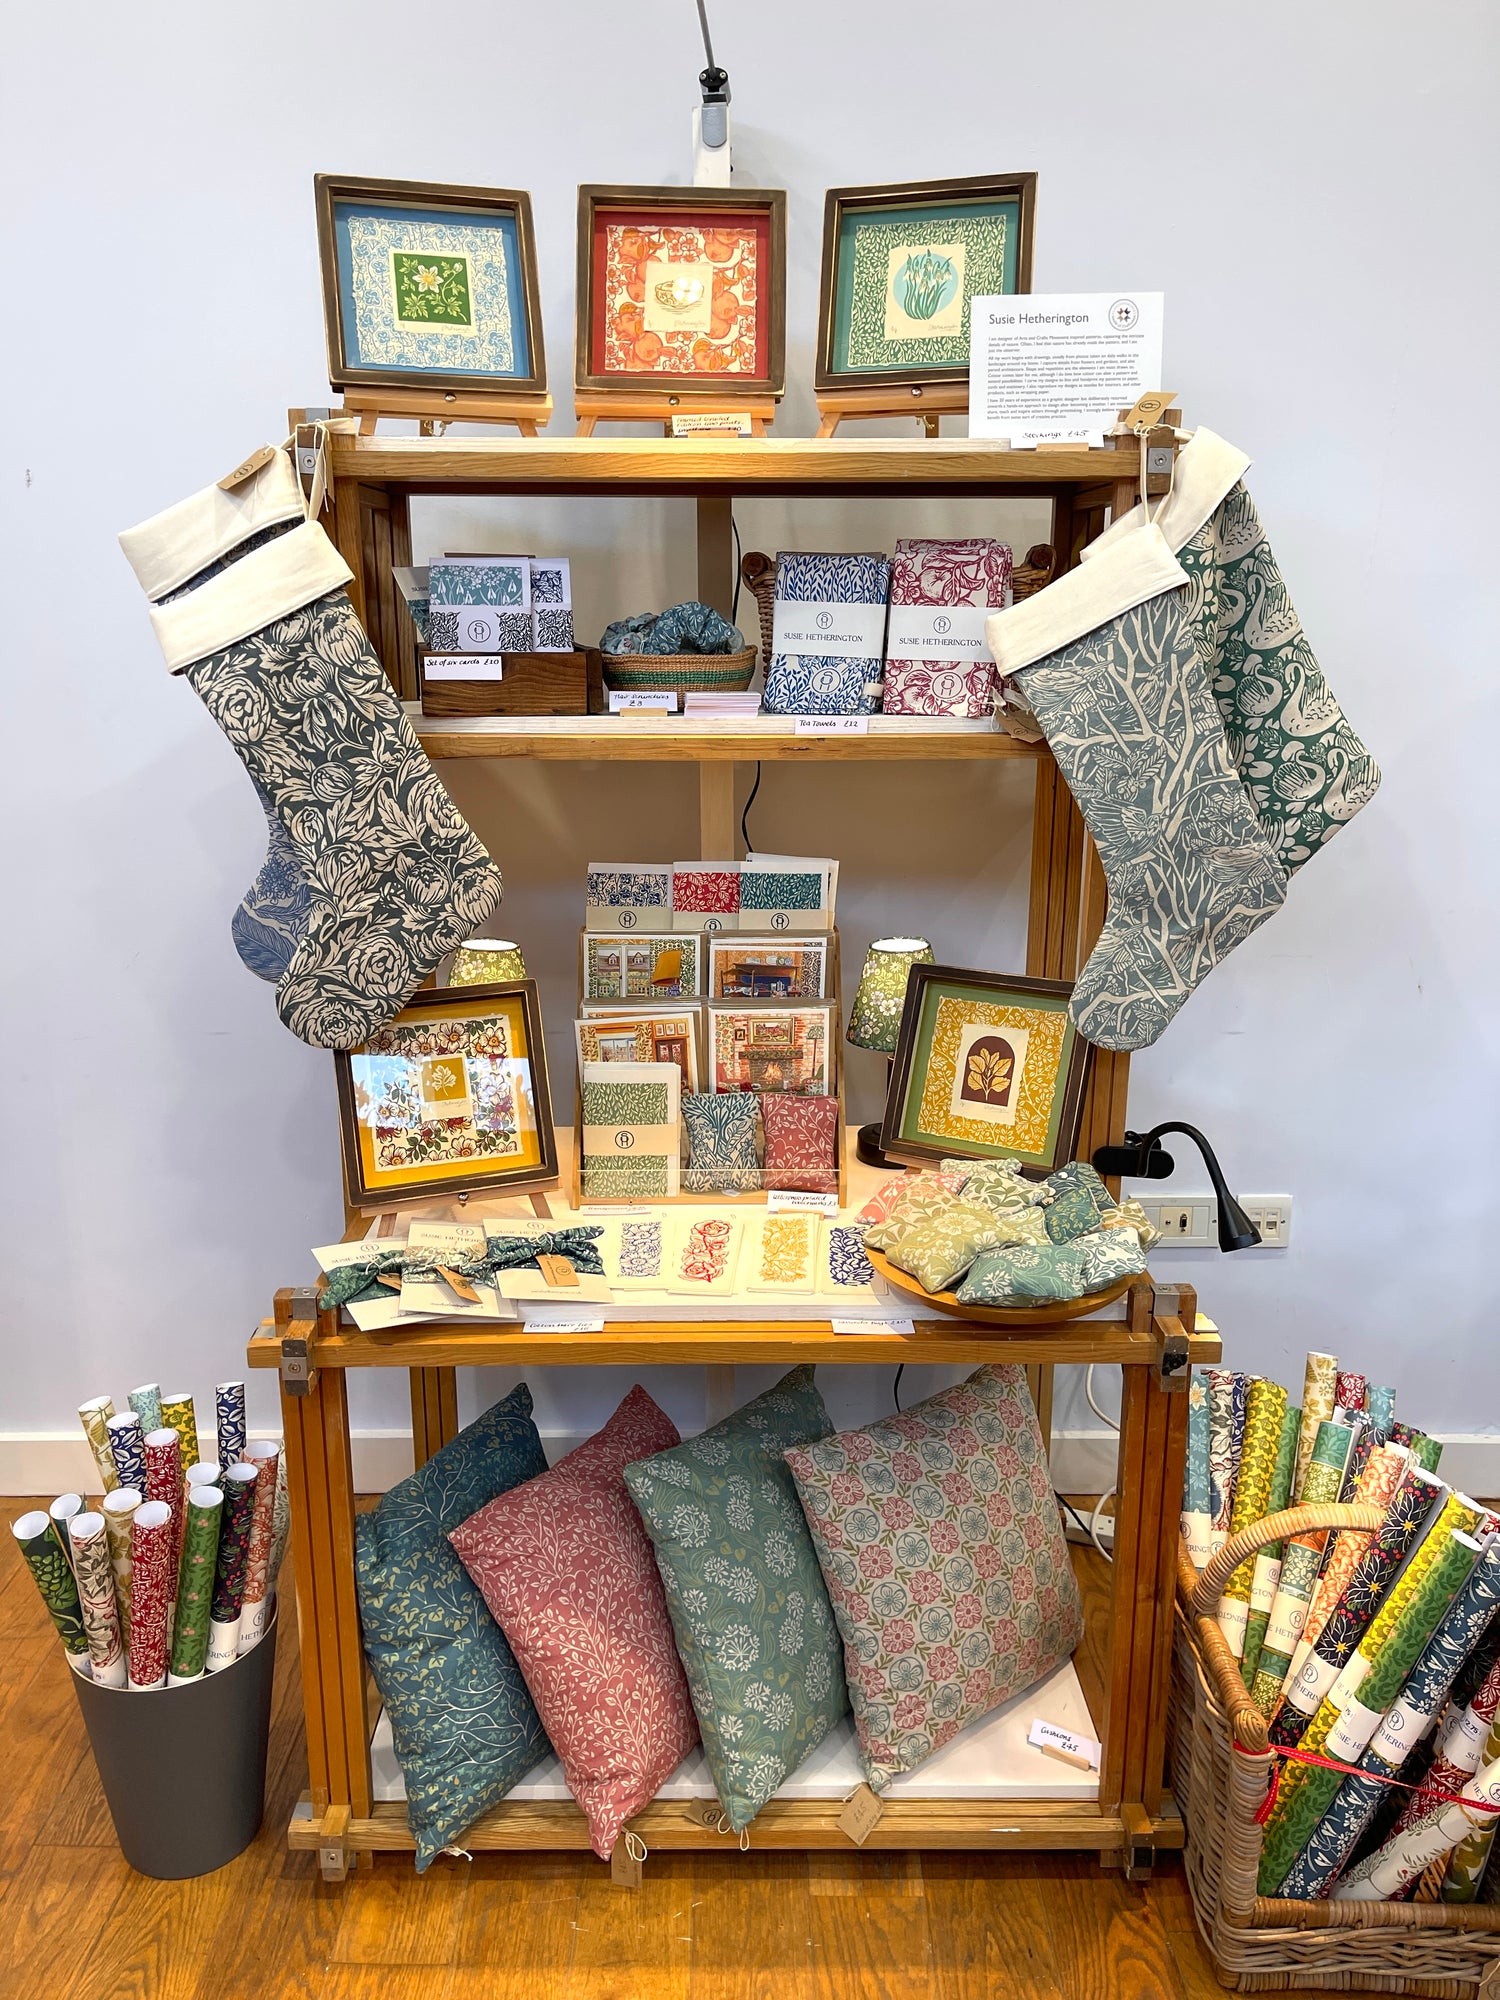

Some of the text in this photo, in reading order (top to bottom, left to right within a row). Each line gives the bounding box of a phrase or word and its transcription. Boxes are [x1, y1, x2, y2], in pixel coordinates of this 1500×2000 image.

[989, 312, 1089, 326] Susie Hetherington
[806, 633, 863, 642] HETHERINGTON
[923, 638, 982, 646] HETHERINGTON
